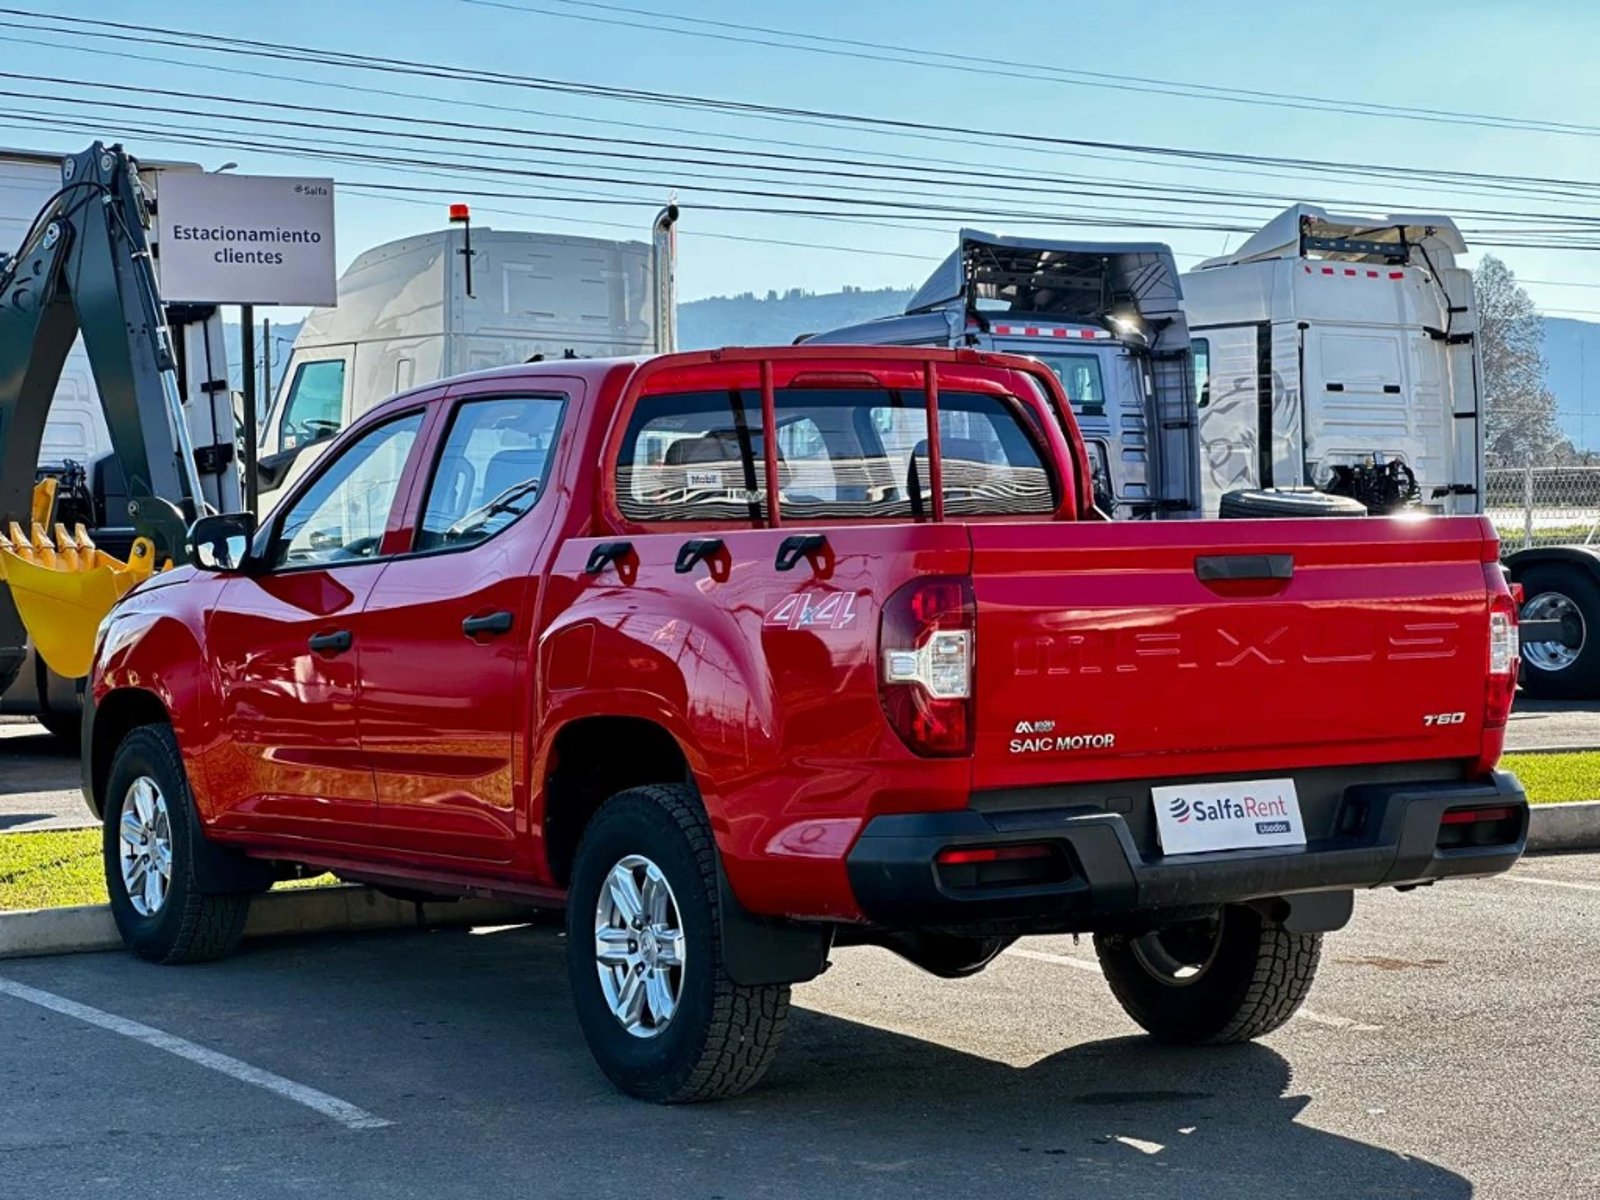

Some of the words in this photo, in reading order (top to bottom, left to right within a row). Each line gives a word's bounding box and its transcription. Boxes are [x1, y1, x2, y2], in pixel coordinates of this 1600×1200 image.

[303, 186, 328, 196] Salfa
[173, 224, 322, 243] Estacionamiento
[214, 248, 283, 264] clientes
[1423, 711, 1466, 726] T60
[1009, 737, 1054, 753] SAIC
[1055, 733, 1115, 751] MOTOR
[1193, 796, 1288, 822] SalfaRent
